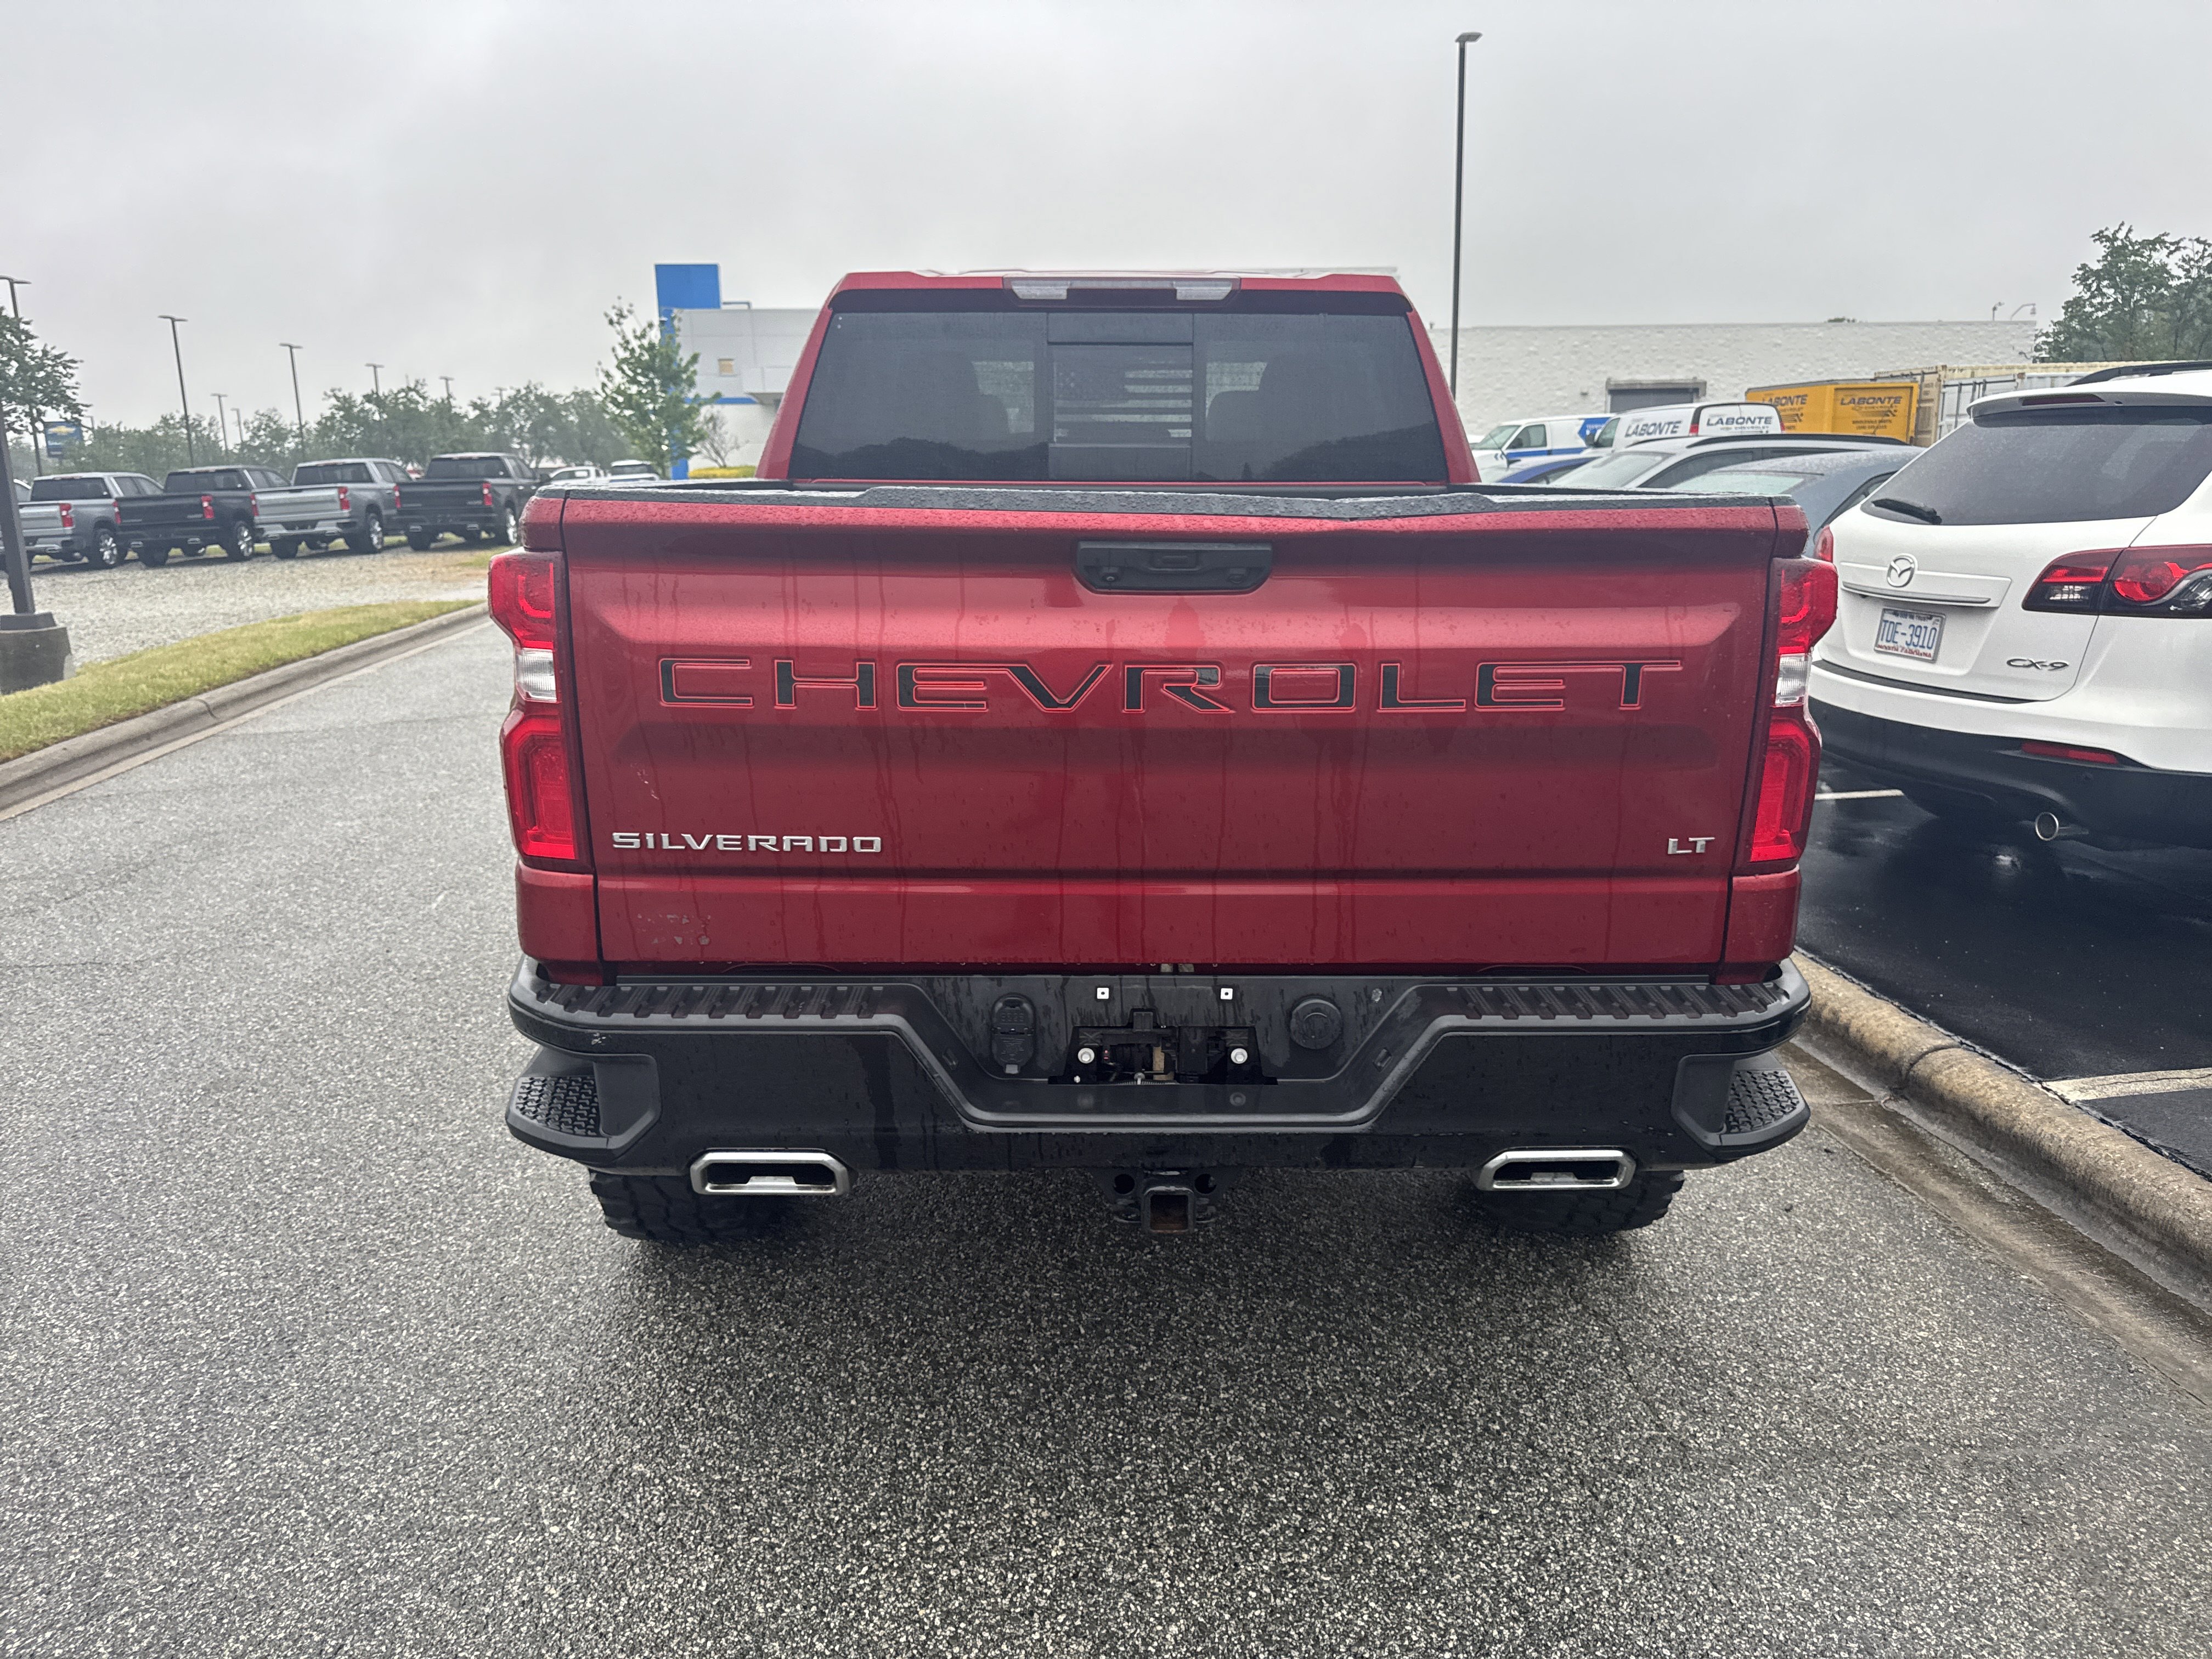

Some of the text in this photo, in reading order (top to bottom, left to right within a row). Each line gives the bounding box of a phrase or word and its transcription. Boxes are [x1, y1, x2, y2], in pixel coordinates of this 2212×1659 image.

[1840, 396, 1902, 405] LABONTE
[1625, 420, 1683, 437] LABONTE
[1706, 416, 1773, 426] LABONTE
[2006, 657, 2070, 671] CX-9
[659, 658, 1683, 713] CHEVROLET
[612, 832, 882, 853] SILVERADO
[1667, 837, 1716, 855] LT
